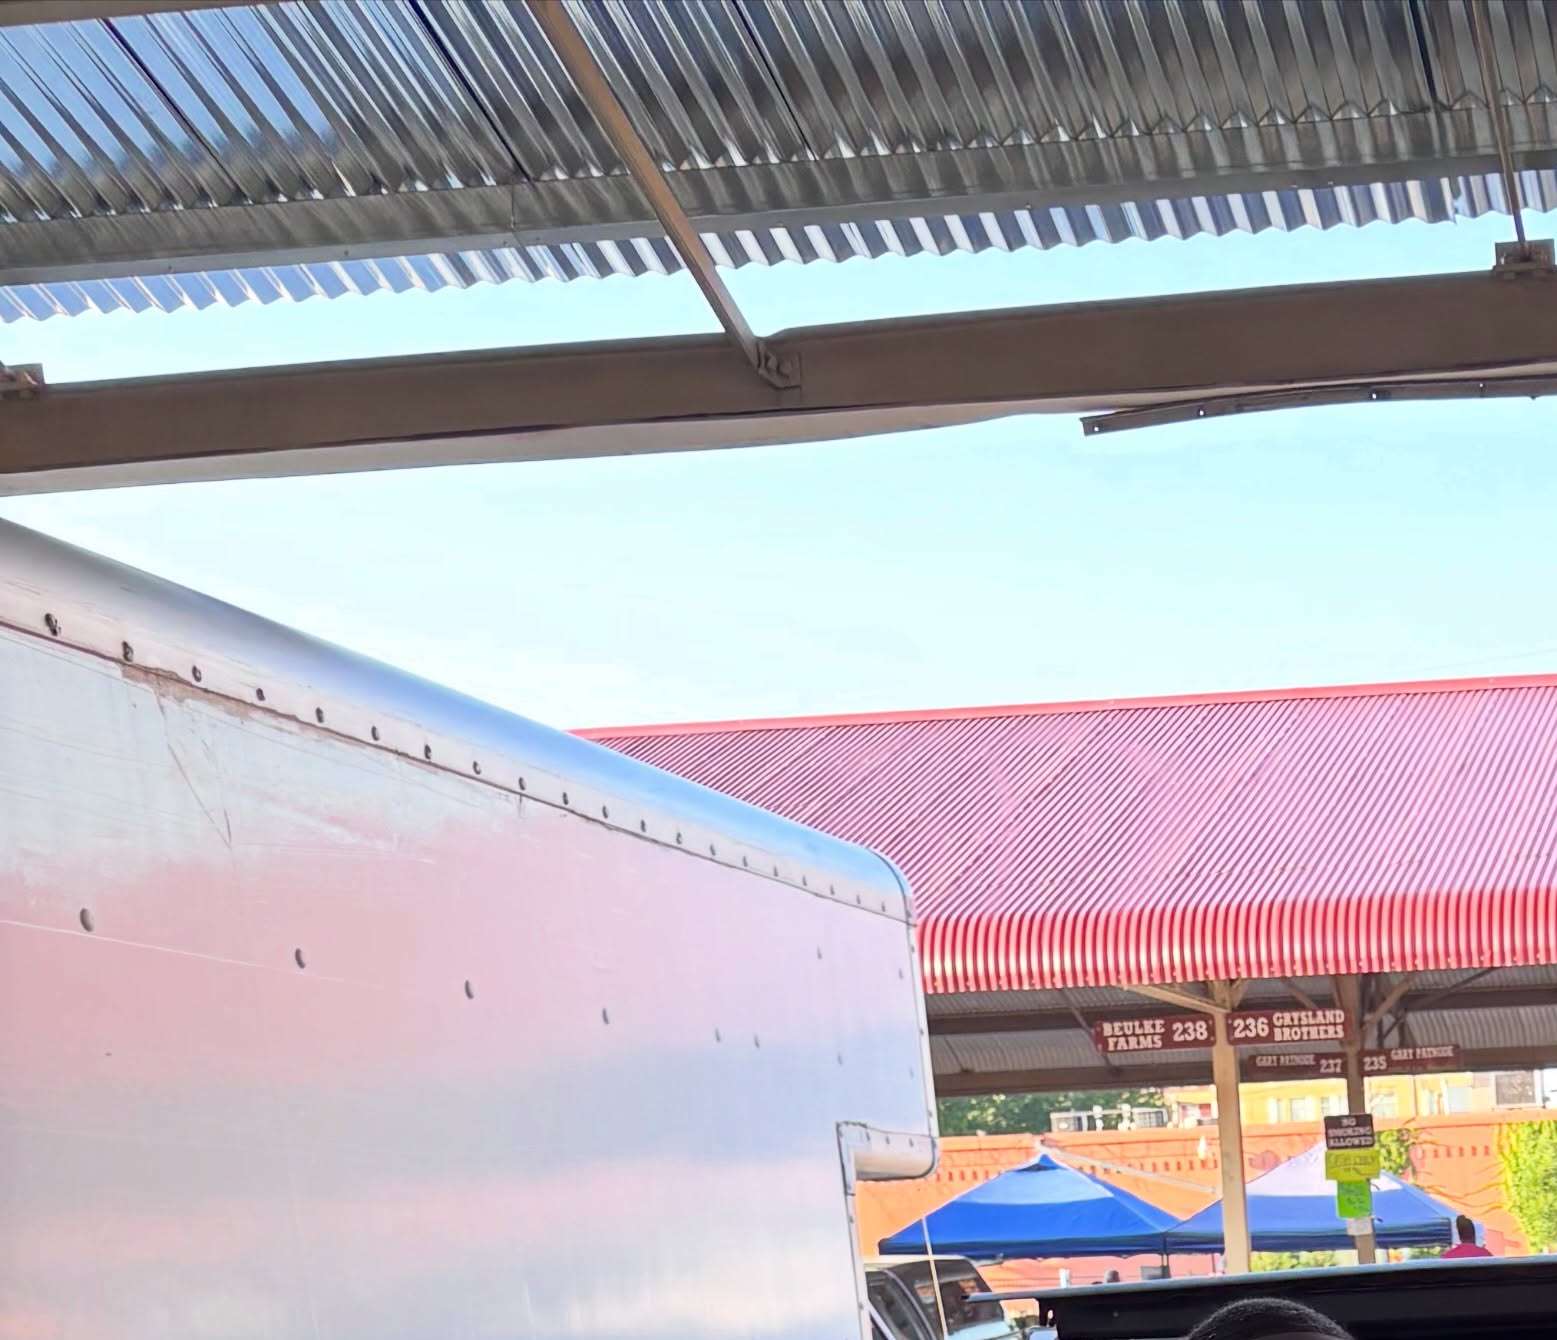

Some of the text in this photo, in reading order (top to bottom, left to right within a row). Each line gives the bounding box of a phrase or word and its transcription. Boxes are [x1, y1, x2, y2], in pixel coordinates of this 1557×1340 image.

[1102, 1018, 1208, 1041] BEULKE 238
[1233, 1017, 1269, 1039] 236
[1273, 1025, 1345, 1041] BROTHERS
[1107, 1034, 1163, 1051] FARMS
[1320, 1059, 1342, 1073] 237
[1363, 1056, 1387, 1071] 235
